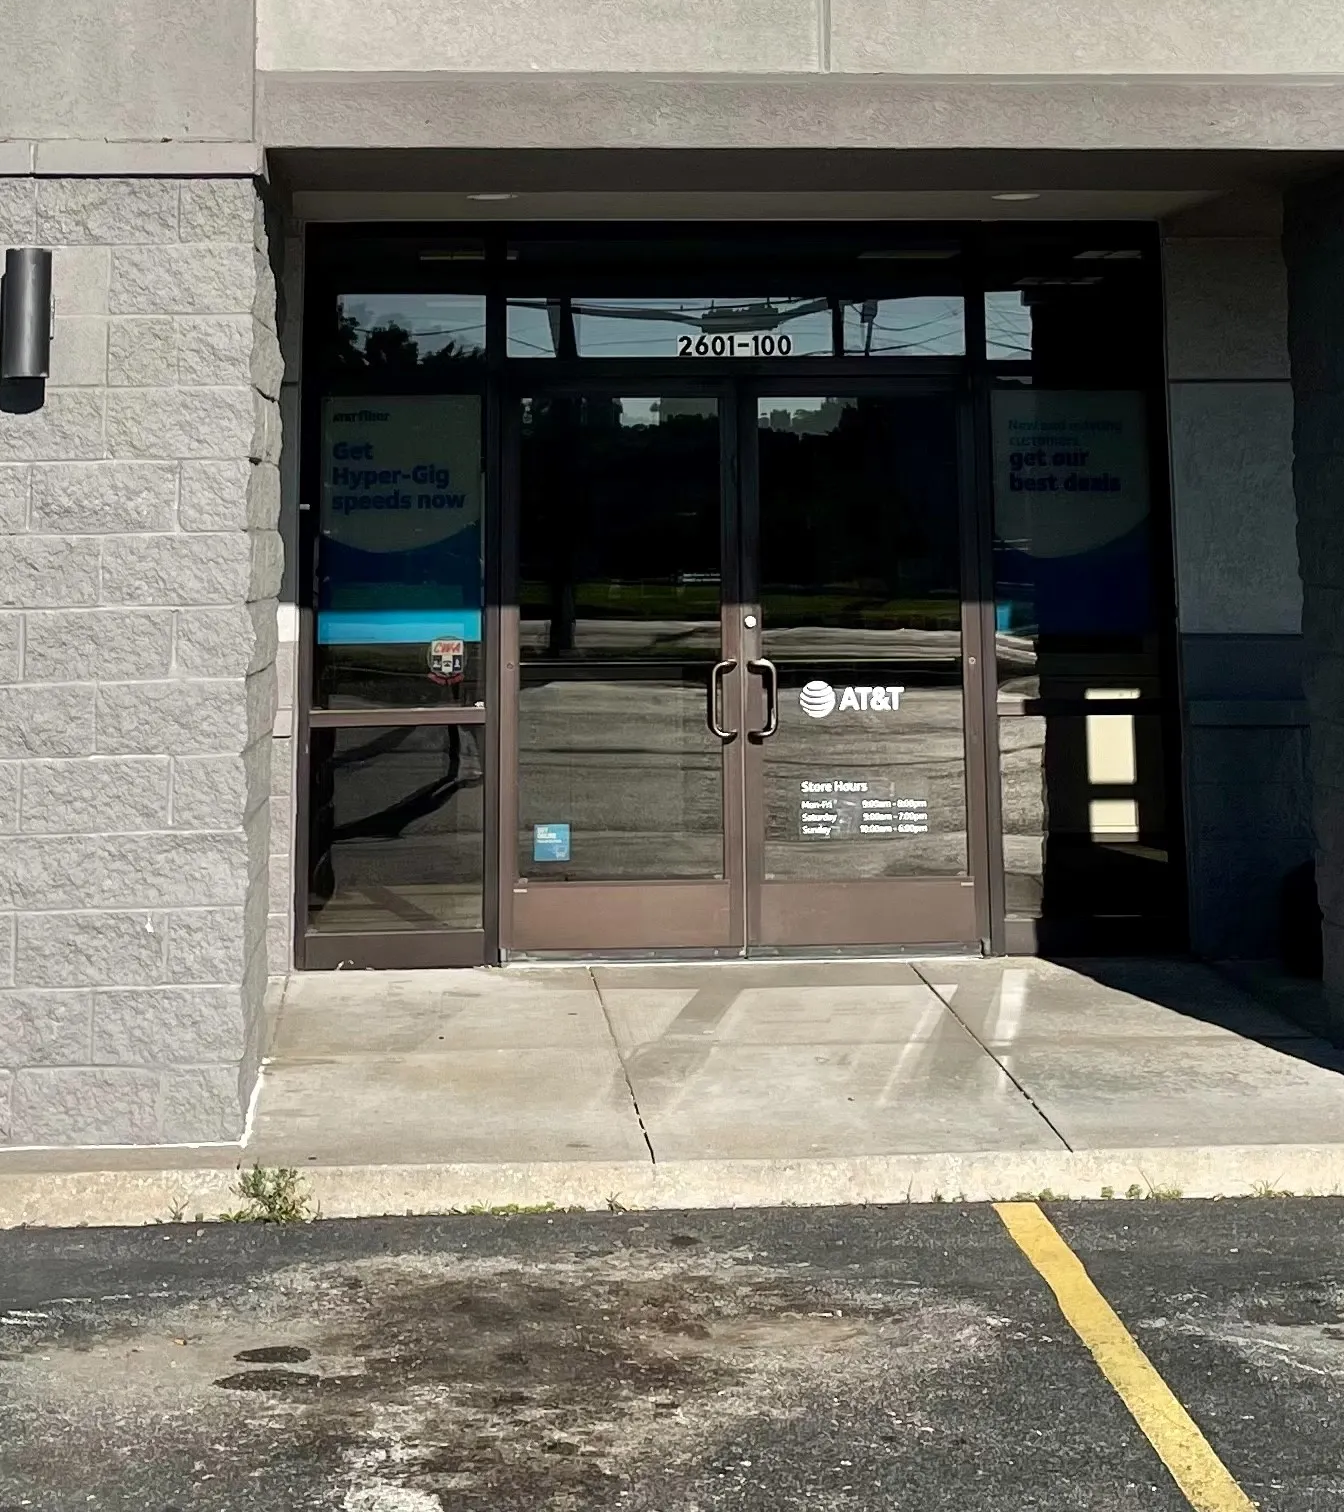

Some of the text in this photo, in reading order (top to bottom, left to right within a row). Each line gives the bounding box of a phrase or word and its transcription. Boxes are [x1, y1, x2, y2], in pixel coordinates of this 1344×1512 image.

[678, 335, 792, 356] 2601-100
[333, 442, 373, 460] Get
[1010, 449, 1089, 470] get our
[332, 464, 449, 490] Hyper-Gig
[1010, 472, 1121, 491] best deals
[332, 490, 466, 515] speeds now
[839, 686, 905, 711] AT&T
[801, 780, 868, 792] Store Hours
[802, 813, 837, 823] Saturday
[802, 825, 832, 835] Sunday
